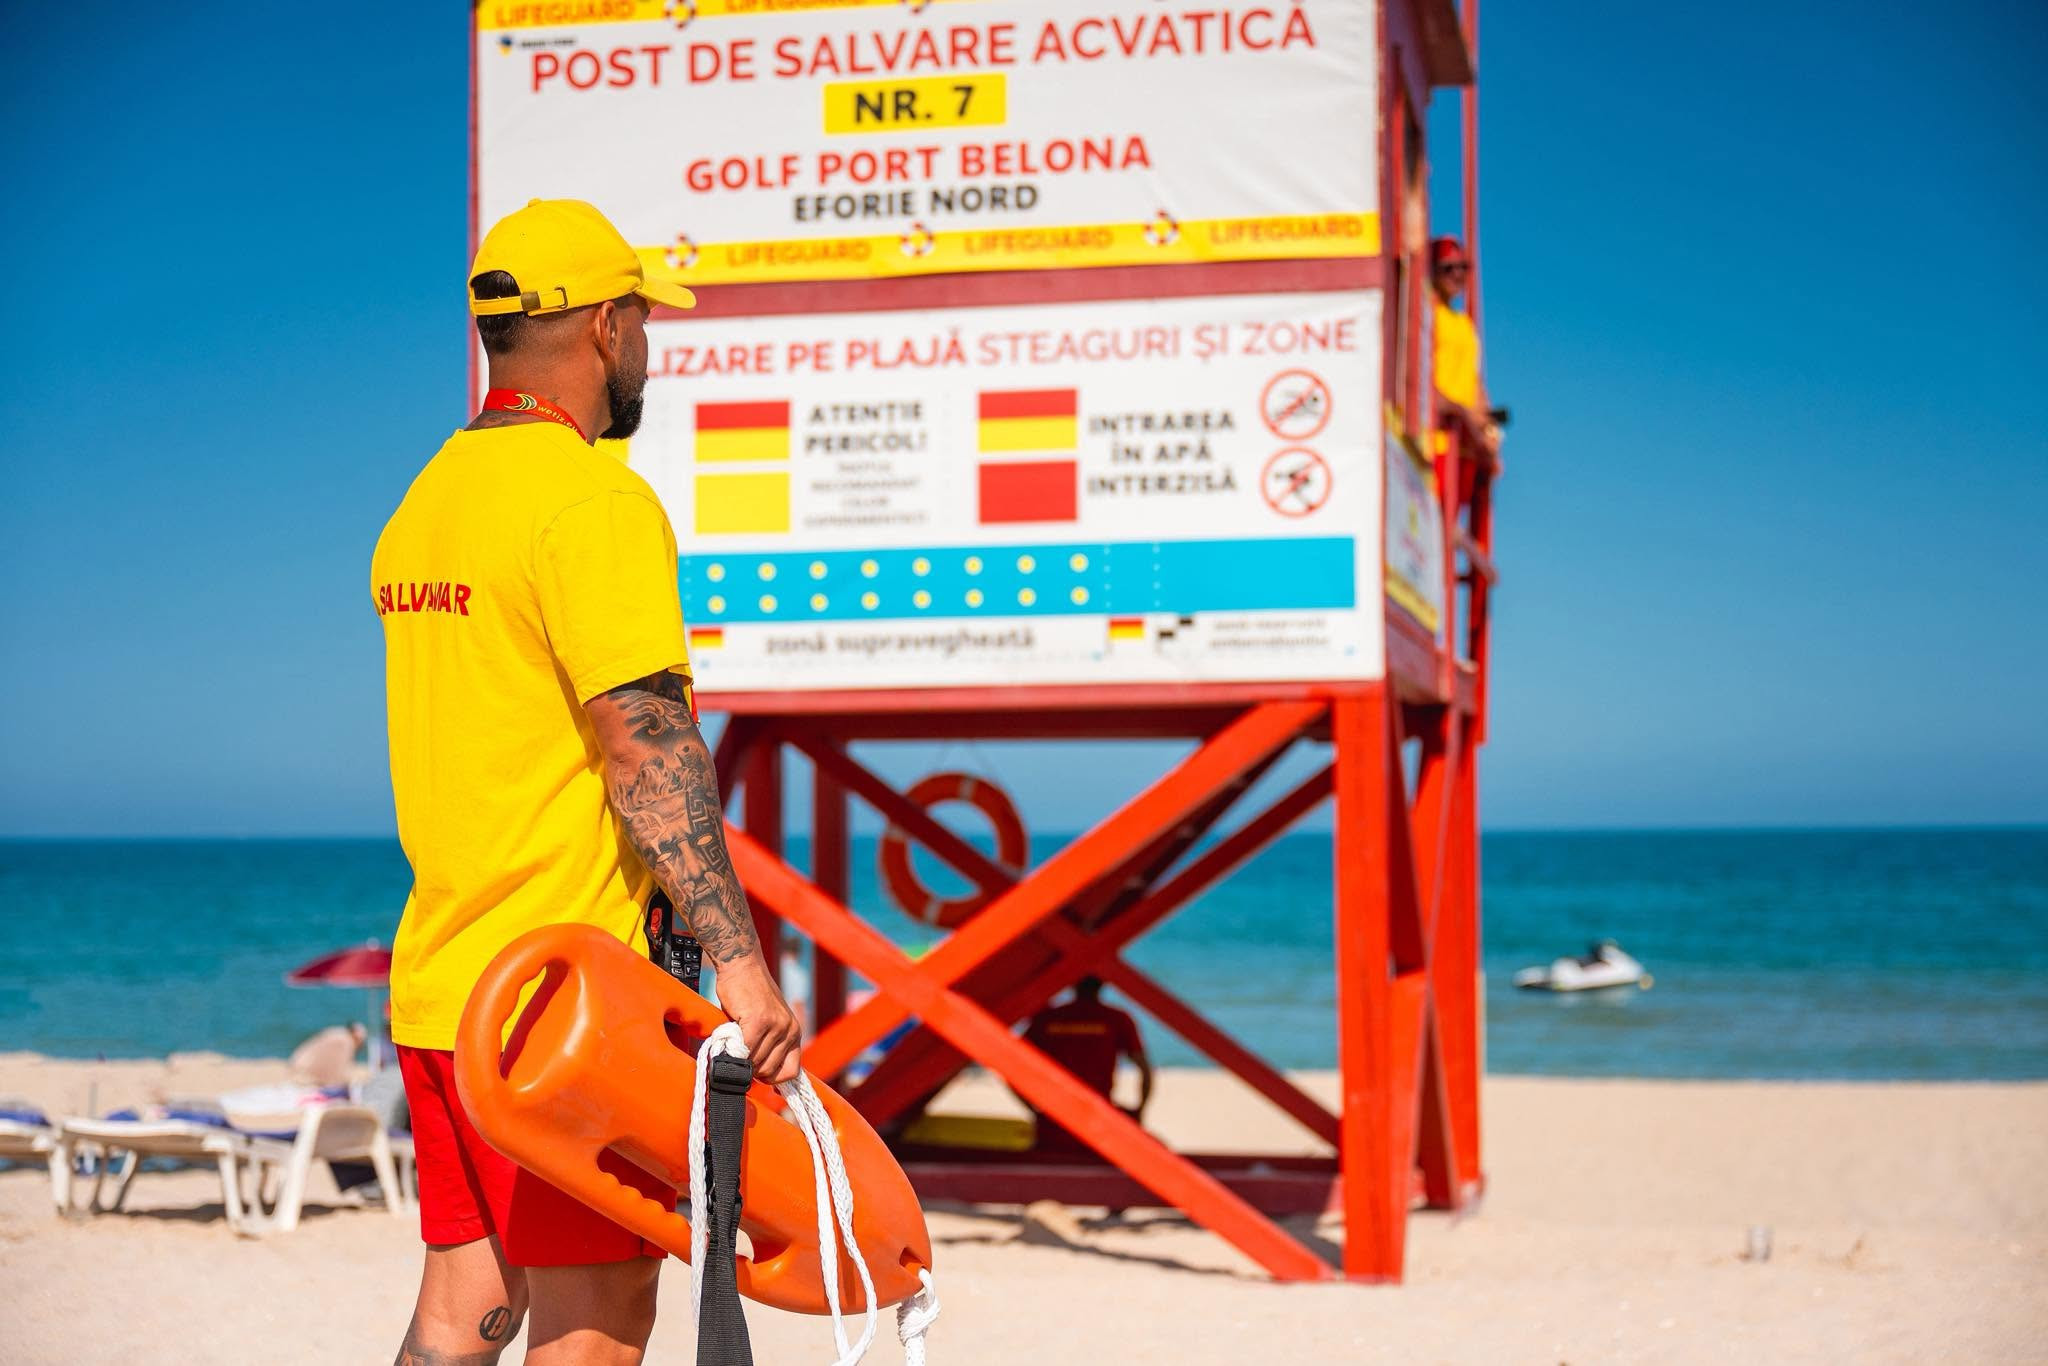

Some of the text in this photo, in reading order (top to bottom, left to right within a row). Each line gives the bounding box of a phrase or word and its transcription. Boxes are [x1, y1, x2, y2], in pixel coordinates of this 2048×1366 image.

[495, 0, 635, 26] LIFEGUARD
[531, 0, 1315, 93] POST DE SALVARE ACVATICĂ
[854, 86, 975, 124] NR. 7
[685, 135, 1151, 192] GOLF PORT BELONA
[794, 184, 1039, 222] EFORIE NORD
[727, 216, 1364, 267] LIFEGUARD LIFEGUARD LIFEGUARD
[787, 341, 833, 372] PE
[846, 328, 967, 369] PLAJĂ
[977, 326, 1181, 365] STEAGURI
[1192, 324, 1229, 361] ȘI
[1242, 319, 1356, 354] ZONE
[1089, 410, 1234, 433] INTRAREA
